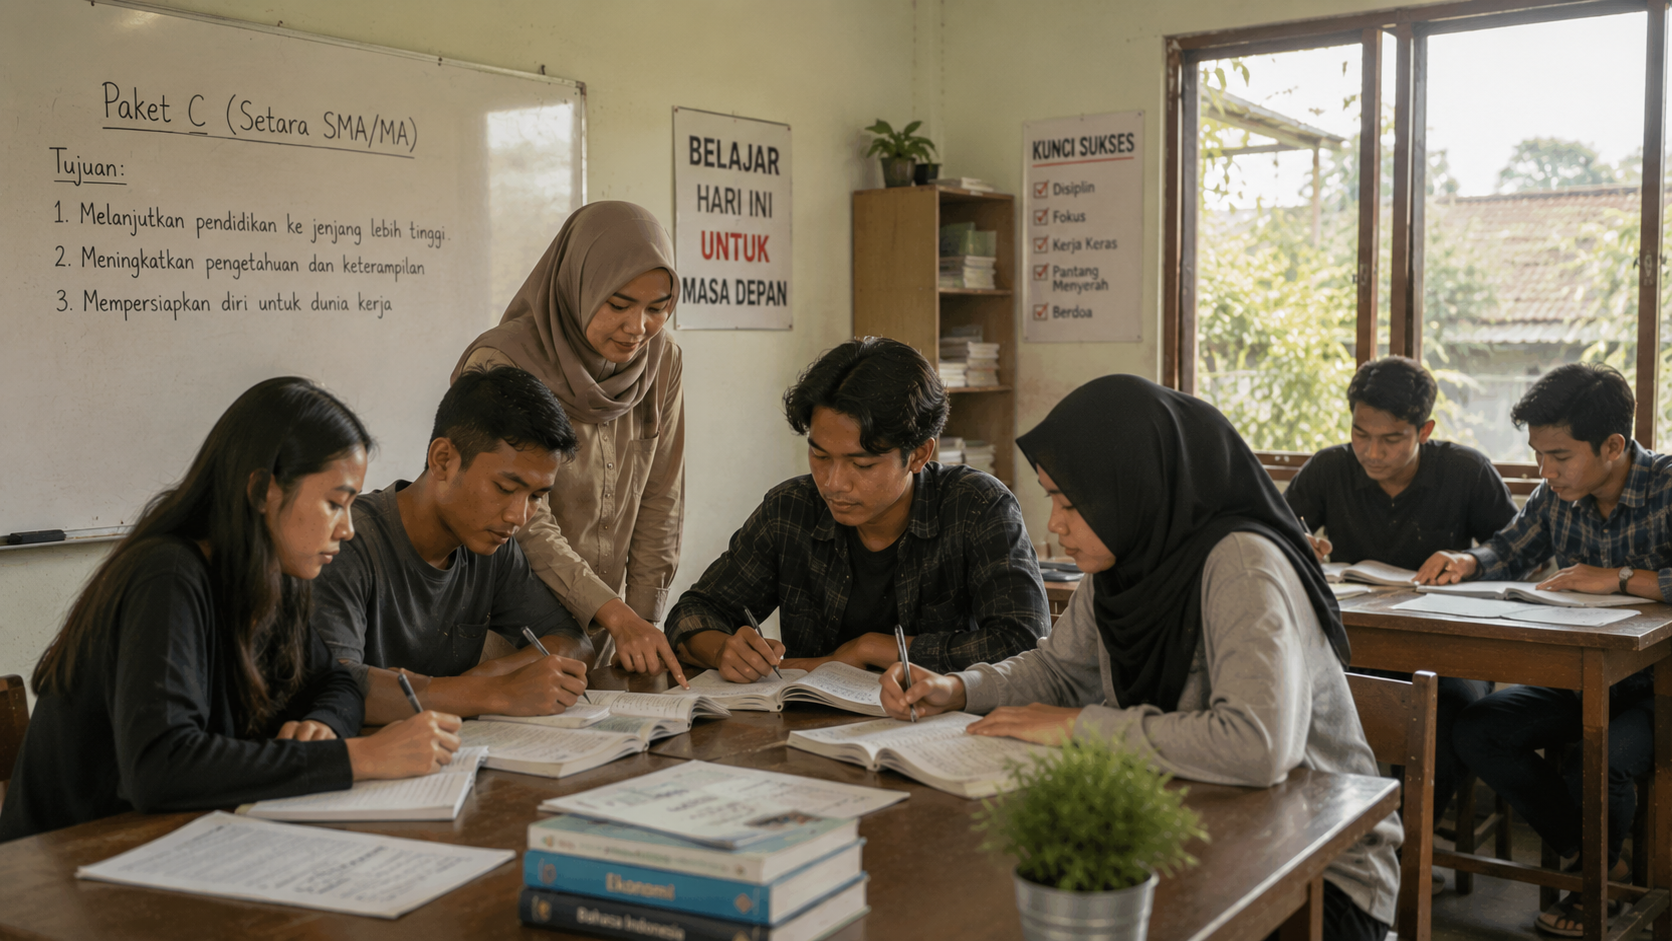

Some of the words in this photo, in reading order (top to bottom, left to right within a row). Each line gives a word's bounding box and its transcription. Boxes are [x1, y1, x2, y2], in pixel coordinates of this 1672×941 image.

[102, 81, 171, 123] Paket
[189, 93, 207, 128] C
[226, 94, 310, 136] (Setara
[323, 110, 418, 153] SMA/MA)
[689, 135, 780, 176] BELAJAR
[1032, 137, 1075, 160] KUNCI
[1079, 132, 1135, 157] SUKSES
[49, 146, 125, 186] Tujuan:
[697, 183, 742, 216] HARI
[749, 189, 773, 218] INI
[1053, 181, 1096, 198] Disiplin
[53, 200, 69, 224] 1.
[79, 201, 186, 237] Melanjutkan
[195, 211, 278, 238] pendidikan
[286, 213, 304, 235] ke
[310, 215, 362, 246] jenjang
[370, 217, 402, 239] lebih
[1053, 210, 1086, 224] Fokus
[701, 230, 770, 263] UNTUK
[1052, 237, 1082, 254] Kerja
[1085, 236, 1118, 251] Keras
[54, 245, 71, 269] 2.
[81, 246, 195, 278] Meningkatkan
[206, 252, 300, 280] pengetahuan
[308, 252, 335, 273] dan
[342, 252, 426, 282] keterampilan
[1053, 265, 1099, 281] Pantang
[682, 276, 731, 306] MASA
[735, 278, 788, 308] DEPAN
[1052, 280, 1109, 295] Menyerah
[56, 289, 73, 312] 3.
[83, 289, 211, 321] Mempersiapkan
[221, 292, 248, 312] diri
[258, 292, 301, 312] untuk
[310, 292, 350, 312] dunia
[358, 292, 393, 320] kerja
[1053, 305, 1093, 319] Berdoa
[605, 872, 676, 901] Ekonomi
[576, 906, 624, 930] Bahasa
